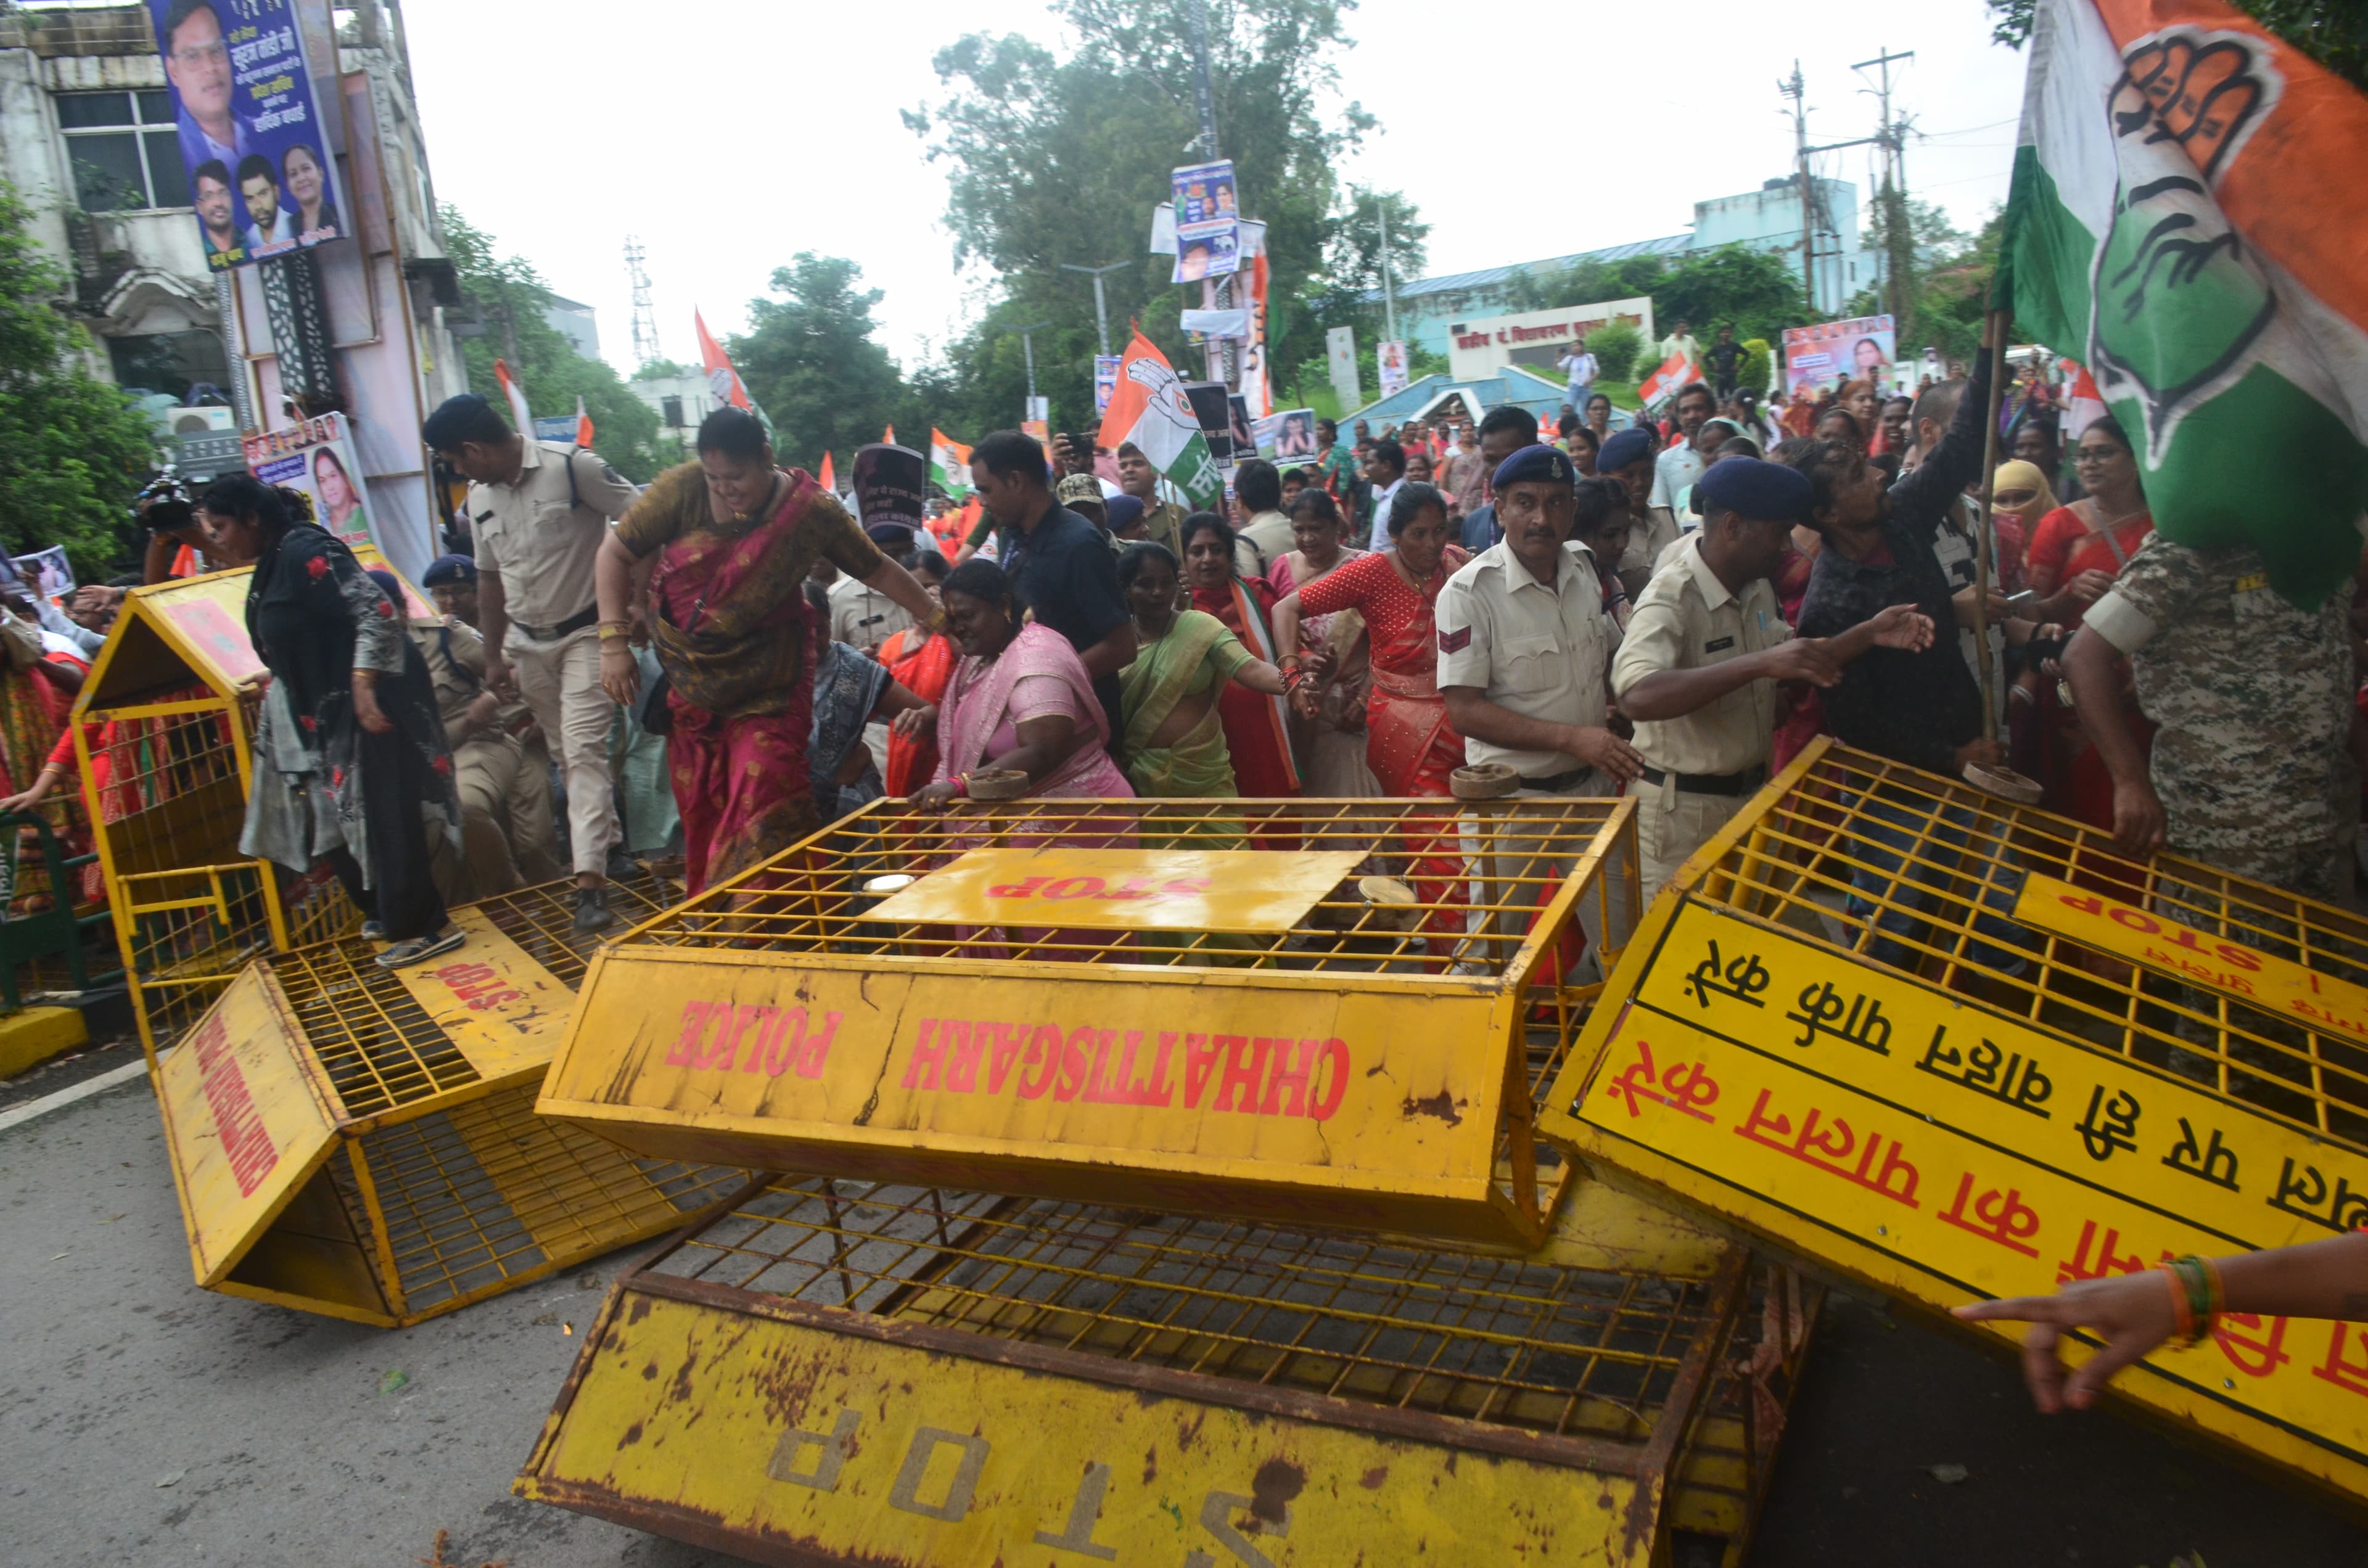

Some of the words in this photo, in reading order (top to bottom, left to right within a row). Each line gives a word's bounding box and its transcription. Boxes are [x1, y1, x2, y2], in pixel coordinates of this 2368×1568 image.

[985, 875, 1212, 901] STOP
[2058, 894, 2262, 972] STOP
[2142, 944, 2257, 996] पुलिस
[434, 962, 521, 1011] STOP
[1684, 938, 1770, 1009] करें
[665, 999, 845, 1080] POLICE
[1786, 982, 1891, 1056] पार्क
[900, 1017, 1351, 1122] CHHATTISGARH
[1606, 1041, 1720, 1124] करें
[1915, 1024, 2052, 1120] वाहन
[202, 1054, 280, 1199] CHHATTISGARH
[1733, 1088, 1920, 1210] पालन
[2074, 1084, 2142, 1162] ही
[2162, 1117, 2241, 1193] पर
[1938, 1172, 2041, 1258] का
